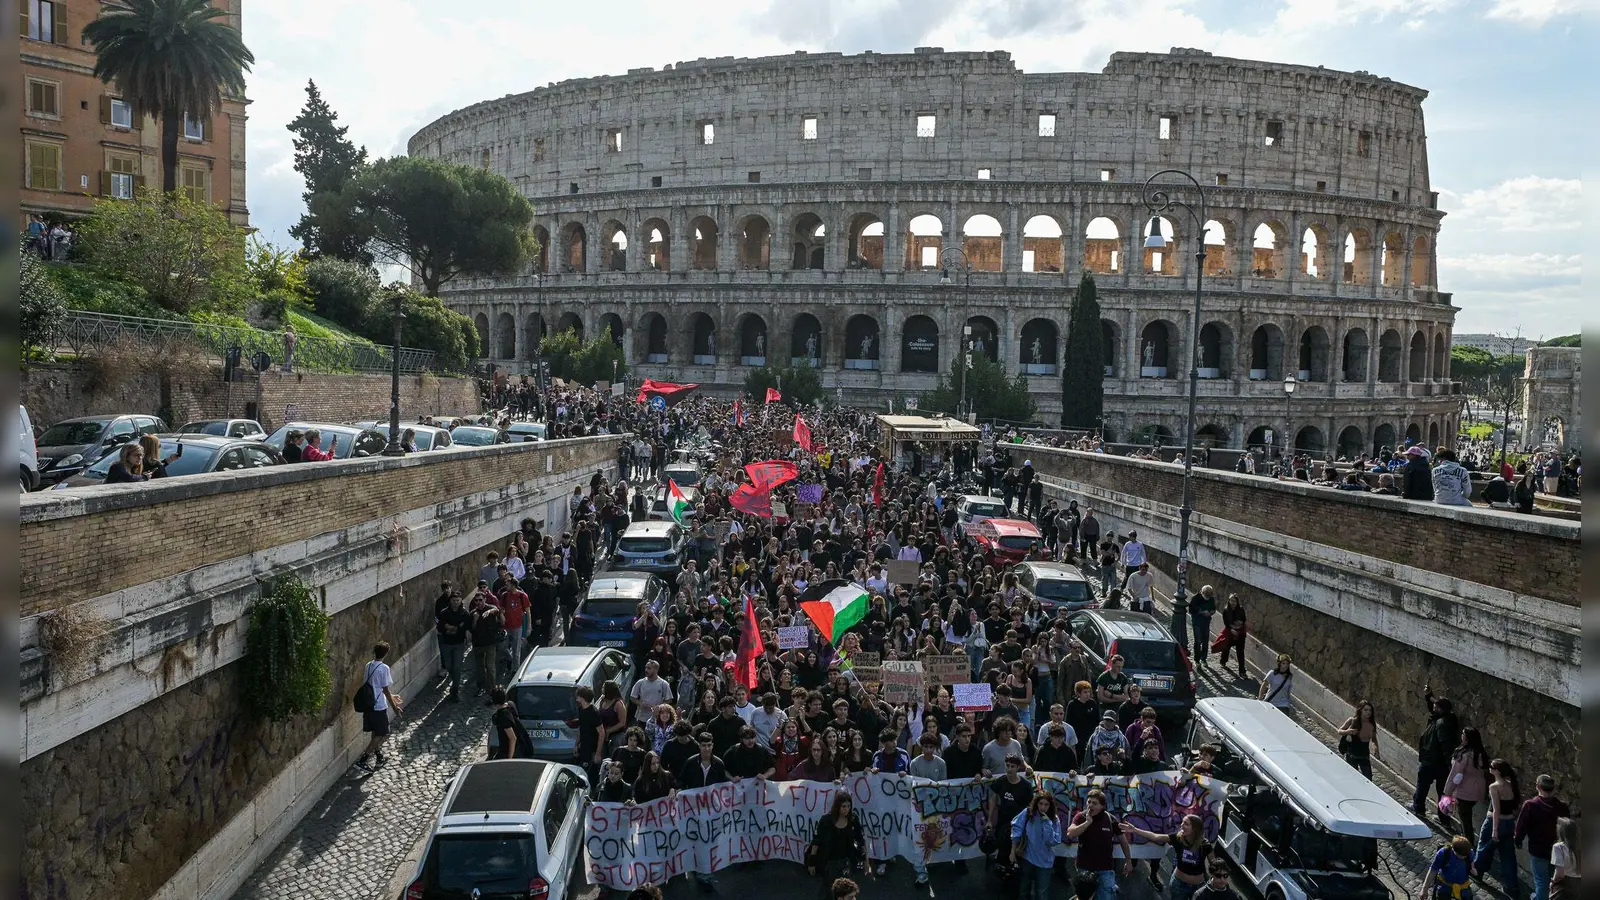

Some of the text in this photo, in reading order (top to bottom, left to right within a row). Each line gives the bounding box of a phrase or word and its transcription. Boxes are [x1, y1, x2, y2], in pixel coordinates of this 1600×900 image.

[789, 776, 872, 813] FUTO
[587, 829, 681, 861] CONTRO
[590, 846, 698, 886] STUDENTI
[710, 845, 722, 873] E
[728, 834, 811, 861] LAVORAT
